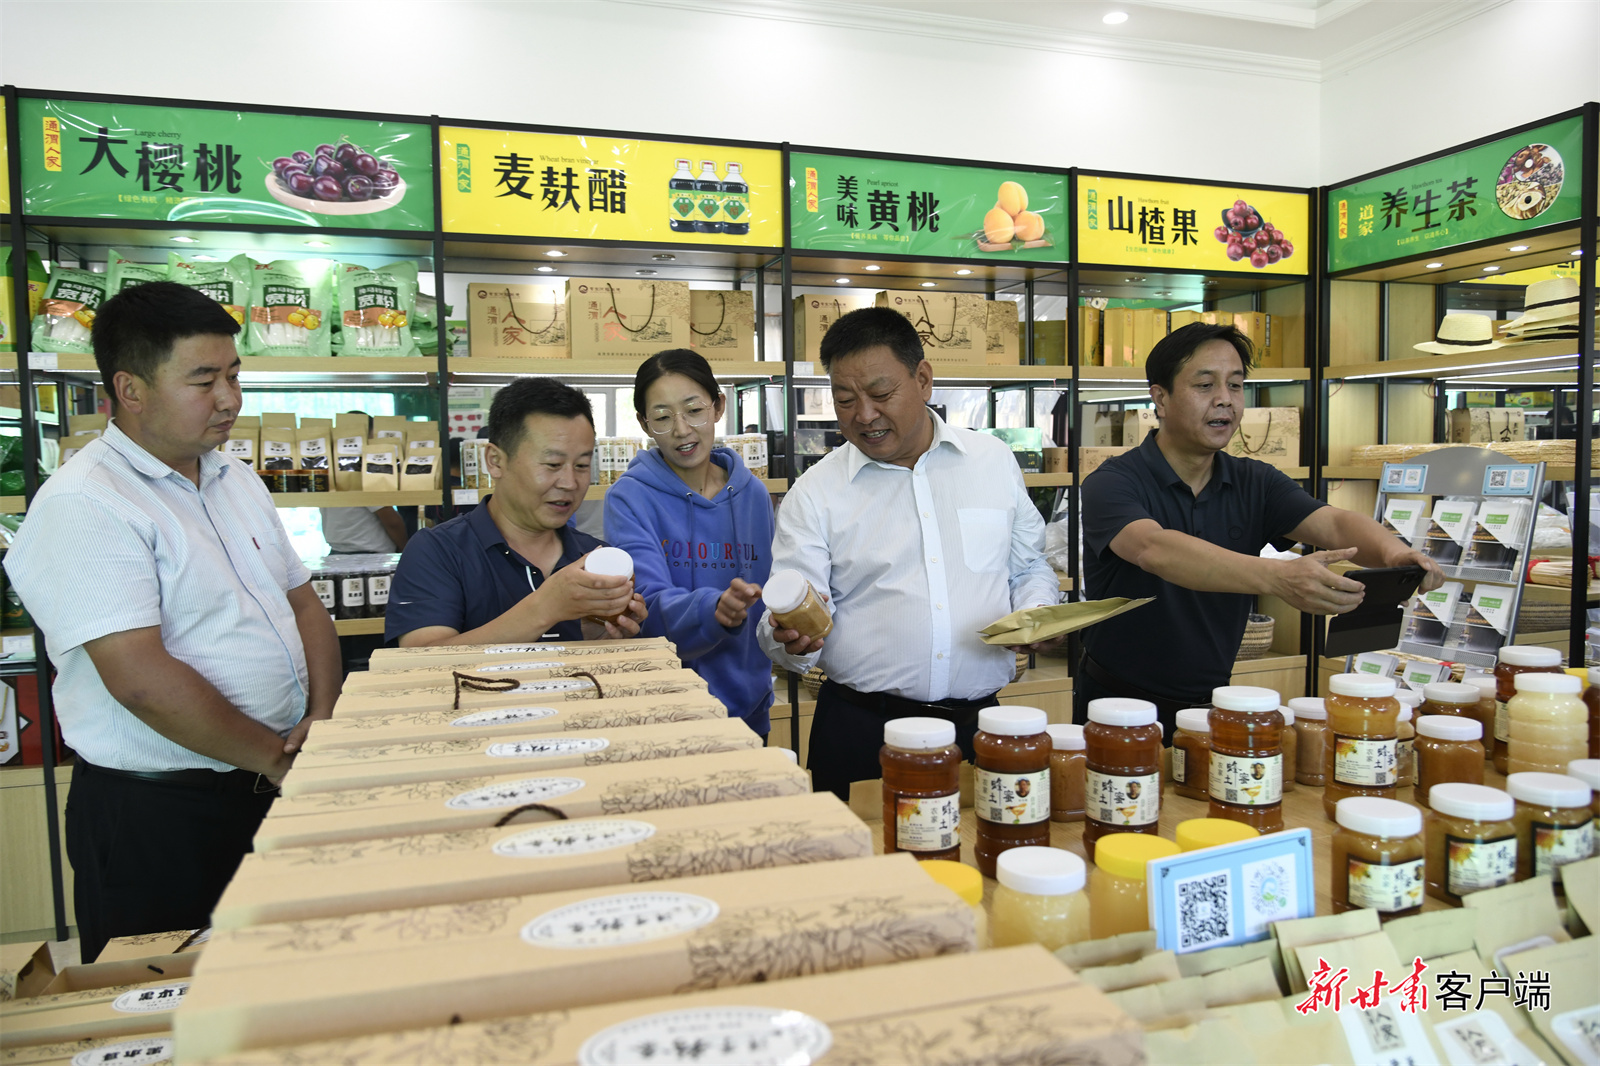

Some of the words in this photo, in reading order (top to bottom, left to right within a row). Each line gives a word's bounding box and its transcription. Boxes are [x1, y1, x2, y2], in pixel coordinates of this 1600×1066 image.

[45, 120, 60, 168] 通渭人家
[134, 129, 156, 138] Large
[157, 130, 182, 140] cherry
[79, 127, 242, 194] 大樱桃
[540, 154, 560, 163] Wheat
[494, 153, 626, 214] 麦麸醋
[837, 174, 859, 229] 美味
[1379, 176, 1478, 232] 养生茶
[867, 189, 940, 232] 黄桃
[1108, 196, 1198, 246] 山楂果
[1358, 204, 1374, 236] 道家
[501, 311, 527, 346] 人家
[602, 306, 628, 342] 人家
[915, 316, 936, 348] 人家
